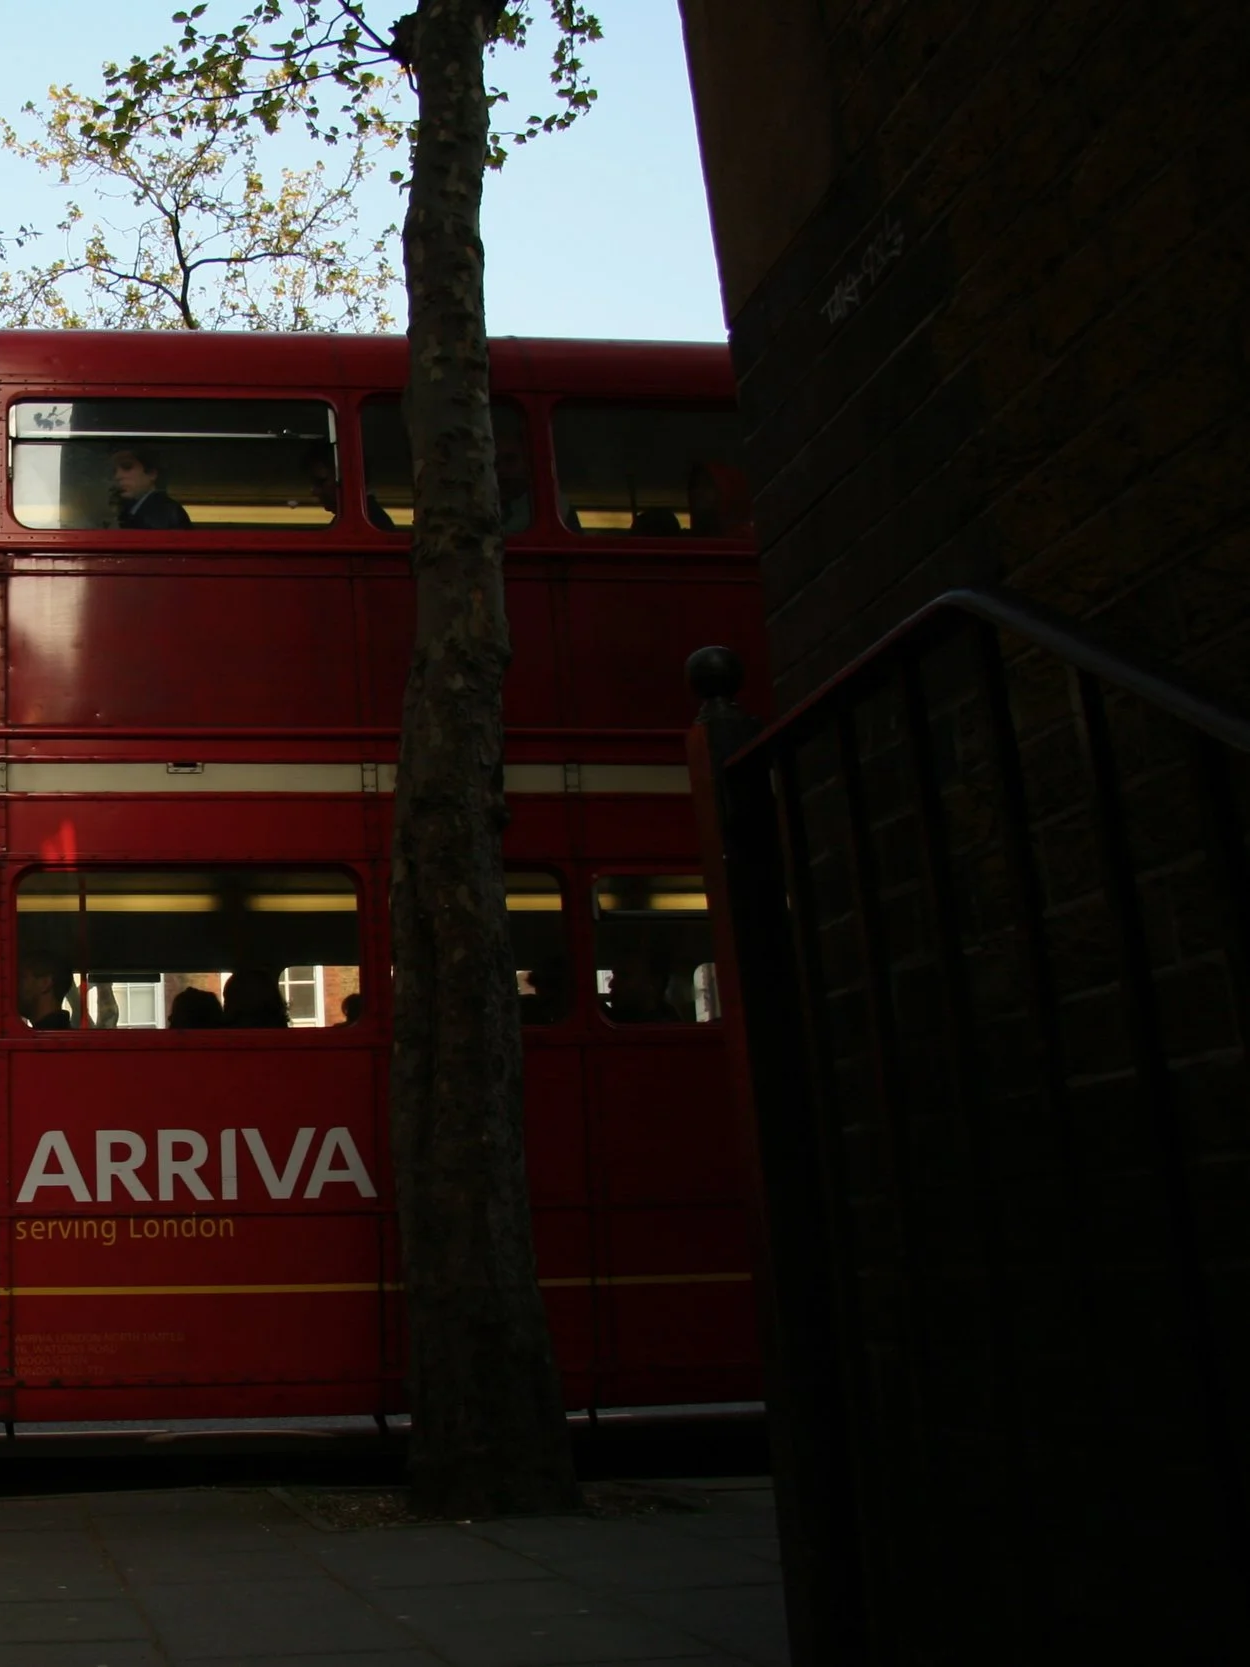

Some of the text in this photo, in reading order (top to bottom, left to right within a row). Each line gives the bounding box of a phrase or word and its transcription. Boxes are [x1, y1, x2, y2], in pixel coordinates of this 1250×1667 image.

[16, 1127, 377, 1202] ARRIVA
[16, 1214, 234, 1245] serving London
